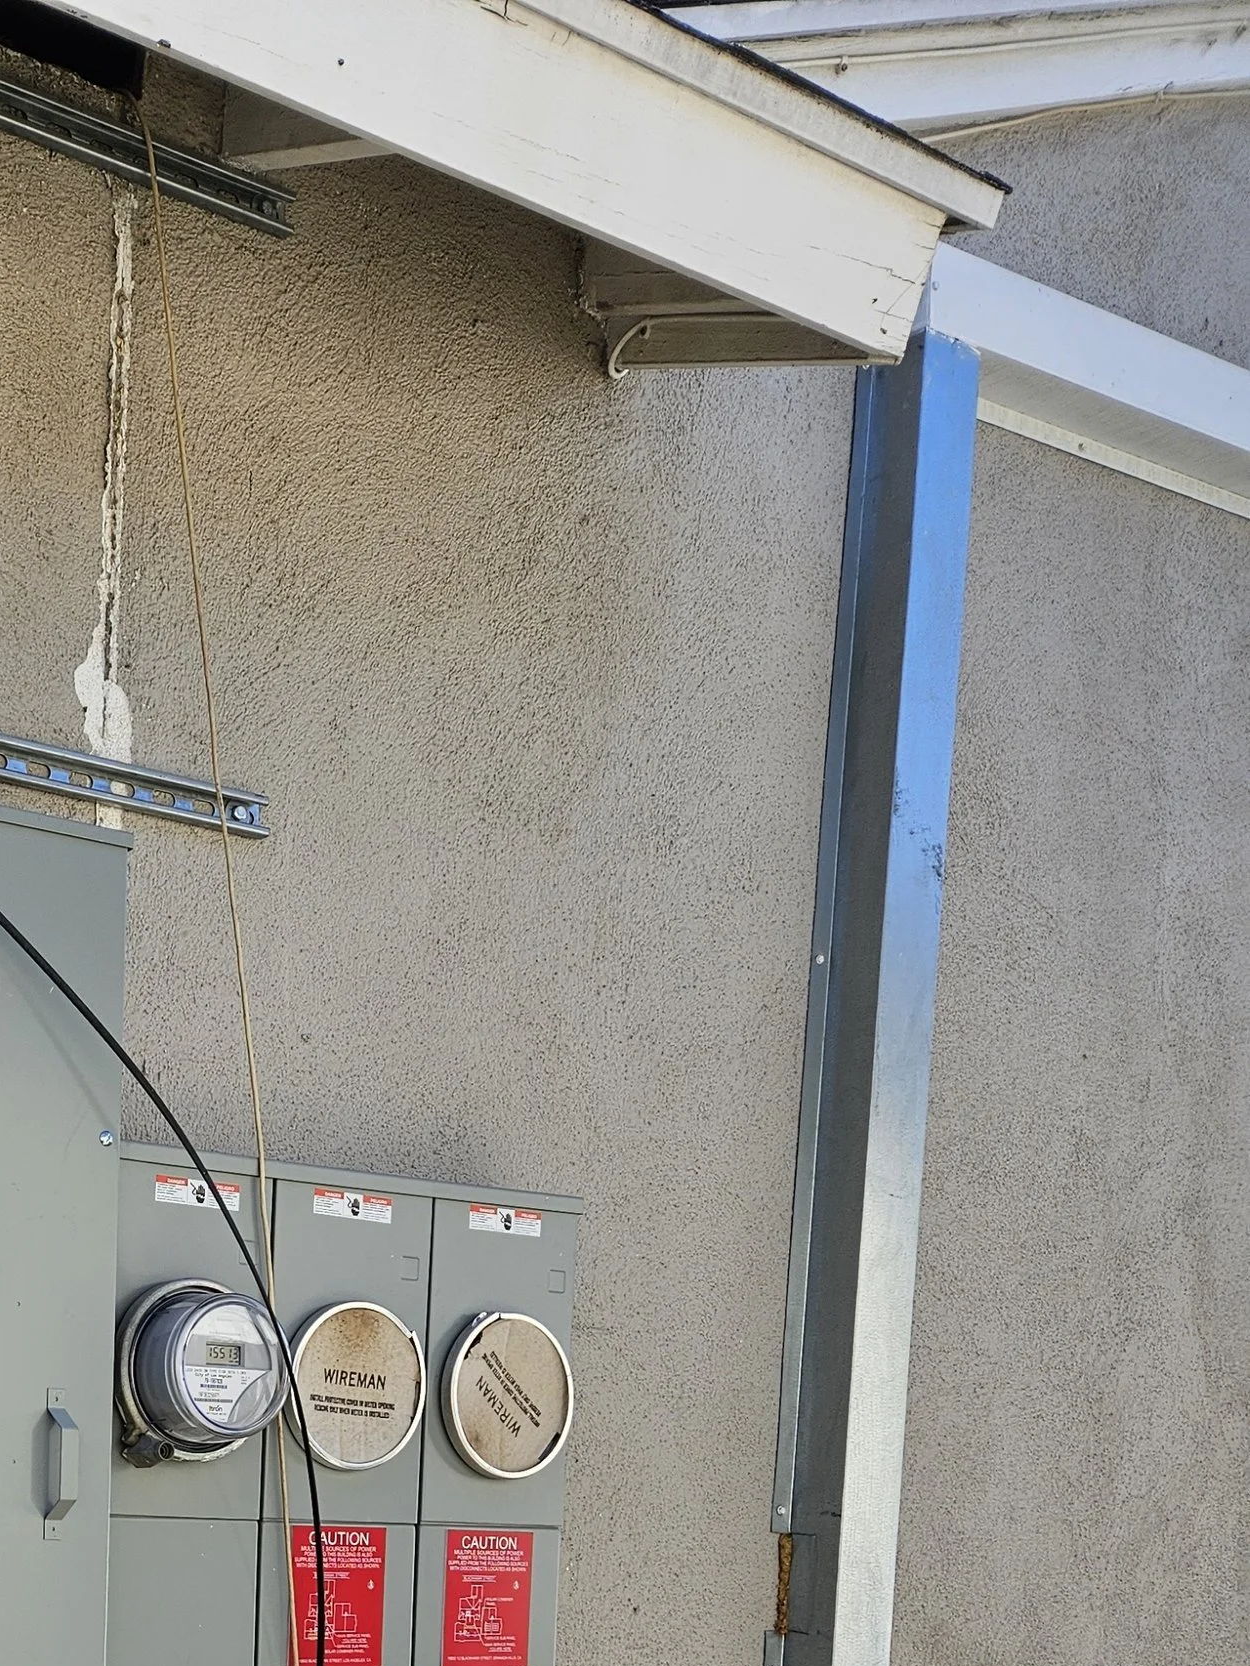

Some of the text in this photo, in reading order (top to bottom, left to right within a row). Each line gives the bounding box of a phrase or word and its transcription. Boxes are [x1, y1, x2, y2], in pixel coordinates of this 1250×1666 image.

[324, 1368, 386, 1390] WIREMAN
[475, 1376, 521, 1438] WIREMAN
[309, 1531, 369, 1546] CAUTION
[461, 1535, 517, 1550] CAUTION
